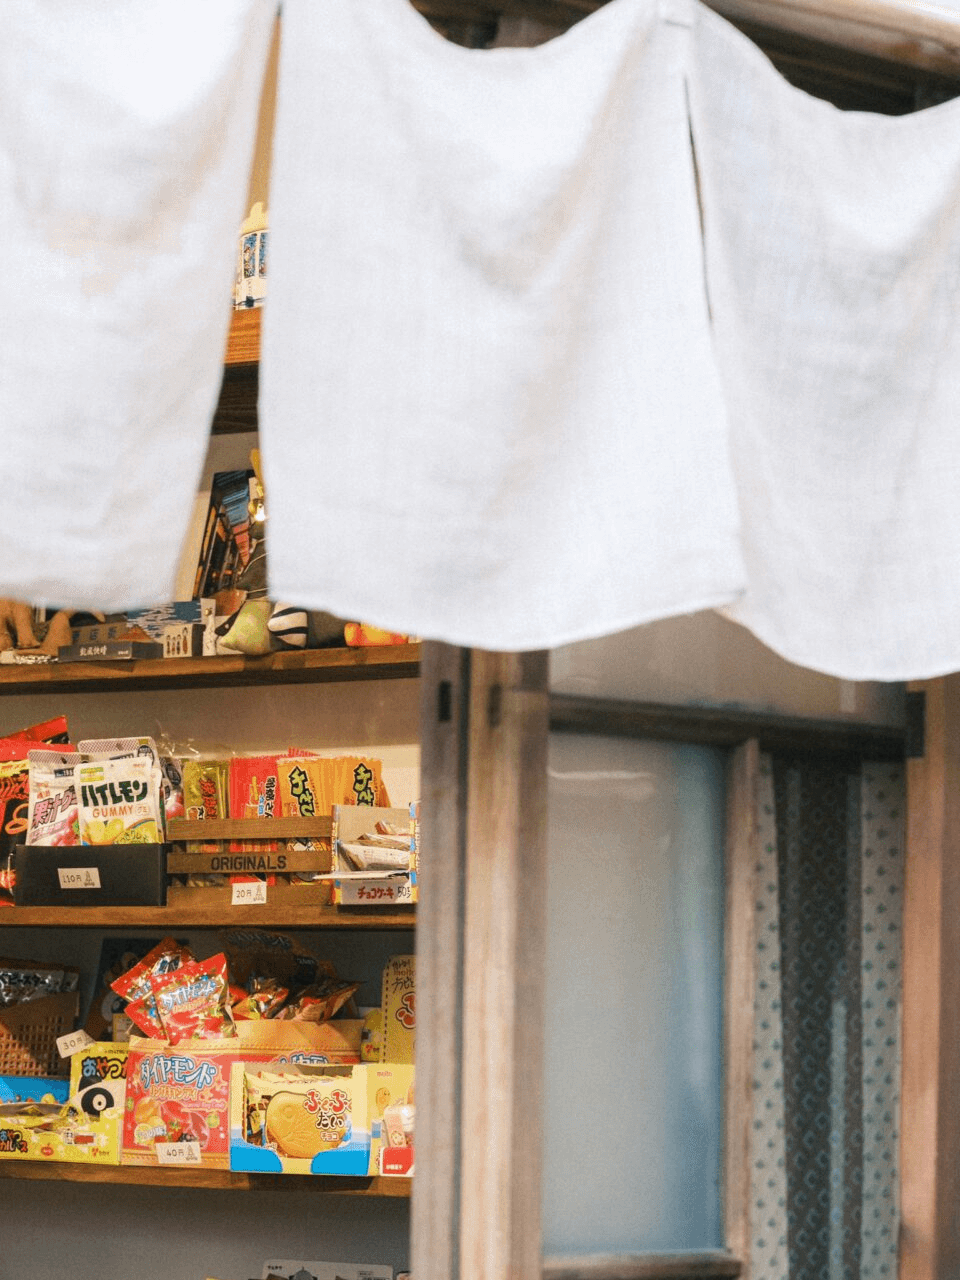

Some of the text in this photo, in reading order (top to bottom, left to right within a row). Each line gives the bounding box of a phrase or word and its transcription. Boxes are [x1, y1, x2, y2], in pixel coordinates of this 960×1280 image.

[92, 807, 133, 818] GUMMY
[211, 856, 287, 871] ORIGINALS
[235, 888, 252, 898] 20円
[357, 885, 395, 899] チョコケーキ
[62, 1036, 83, 1051] 30円
[141, 1055, 217, 1089] ダイヤモンド
[315, 1112, 345, 1129] たい
[320, 1131, 339, 1142] チョコ
[166, 1149, 184, 1158] 40円
